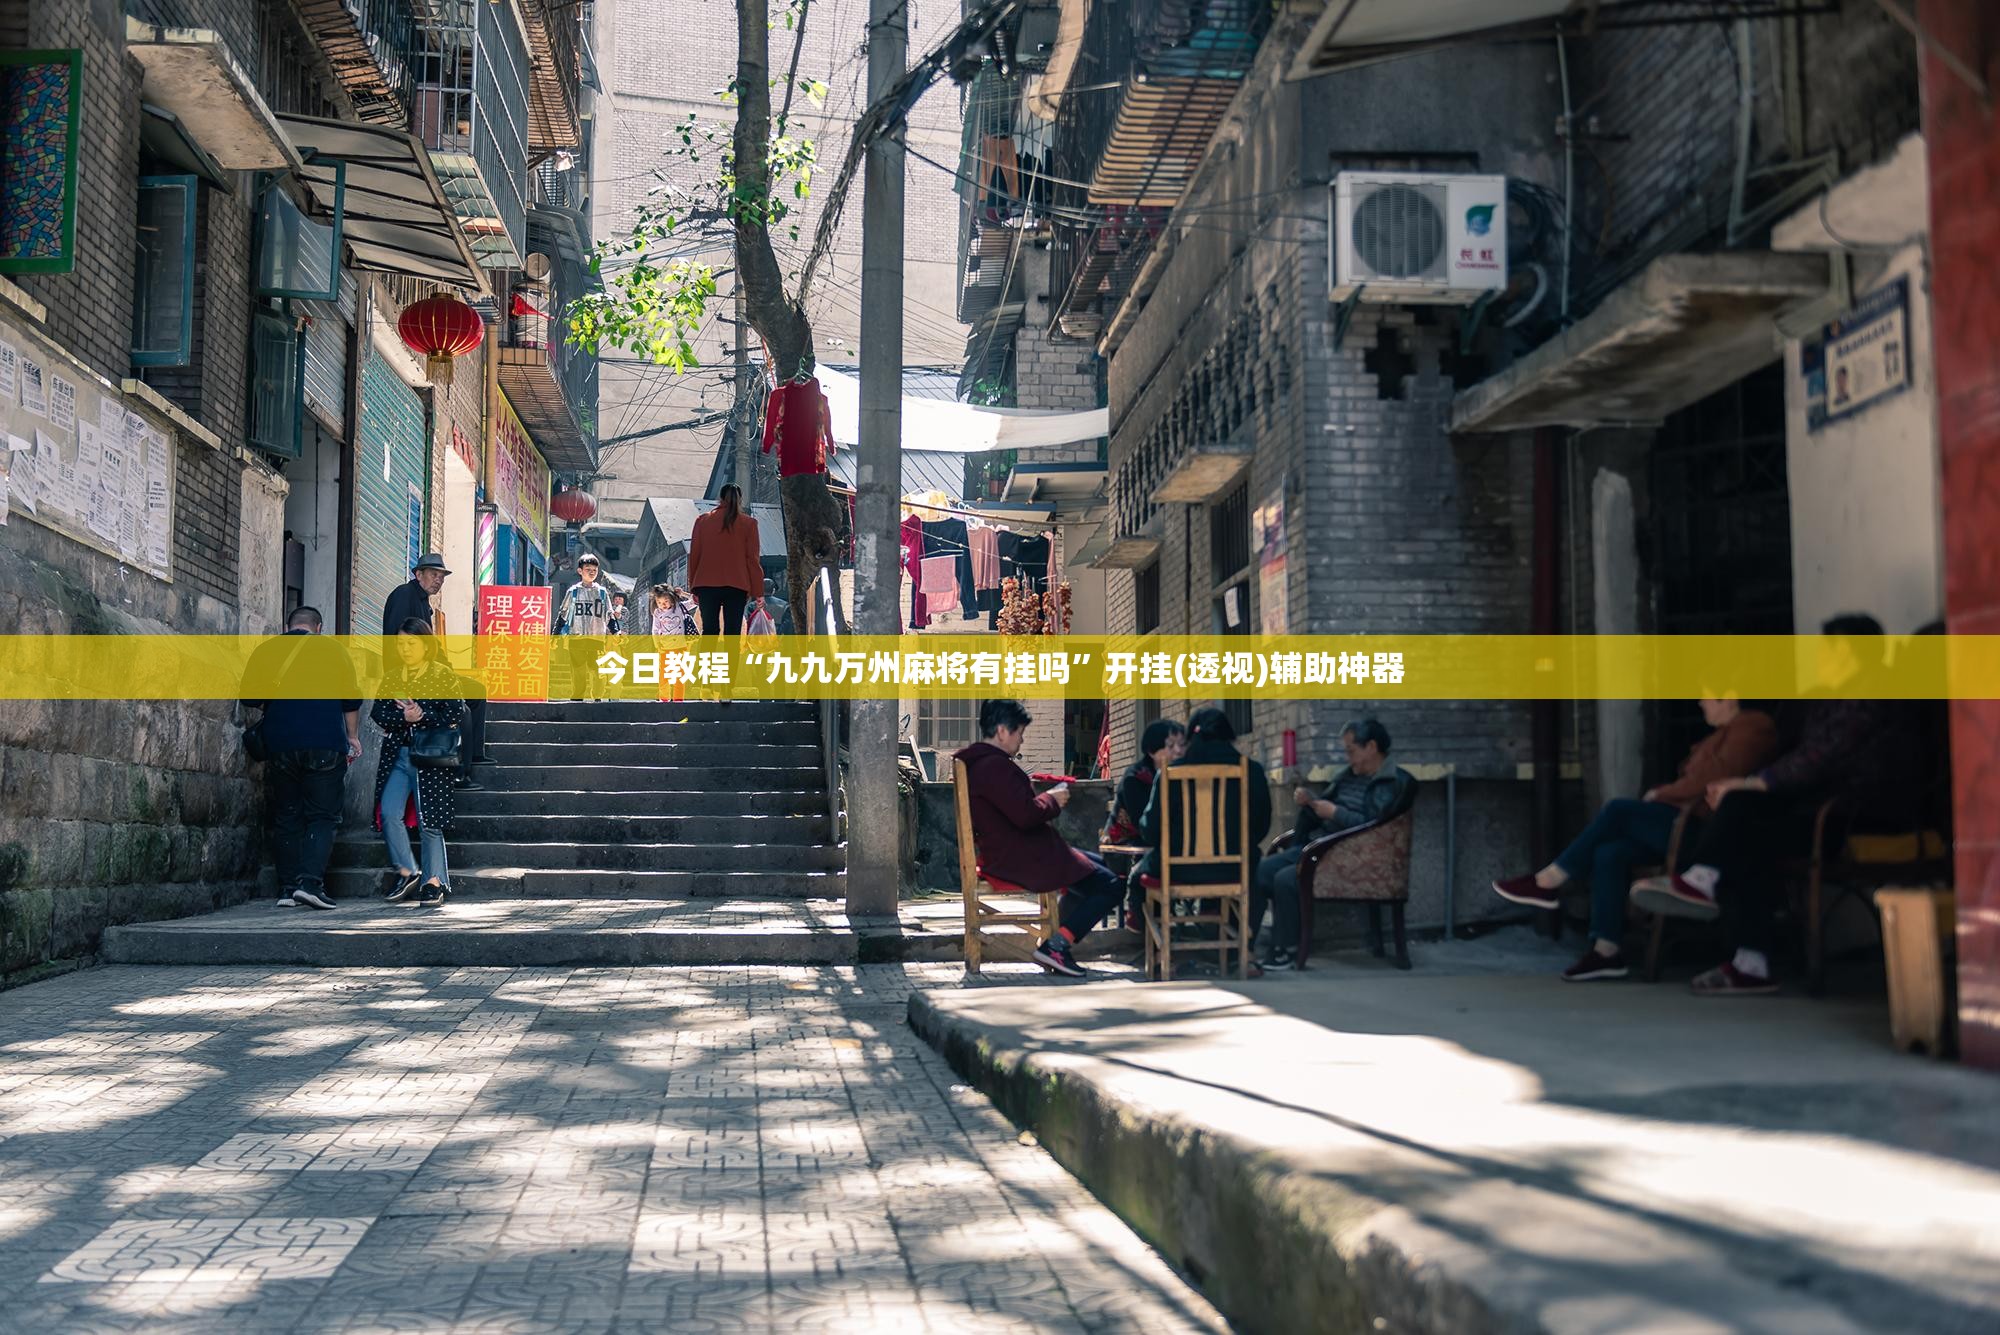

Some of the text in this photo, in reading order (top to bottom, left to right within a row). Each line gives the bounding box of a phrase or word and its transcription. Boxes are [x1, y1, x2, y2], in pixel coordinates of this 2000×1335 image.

[486, 595, 546, 620] 理发
[485, 619, 547, 645] 保健
[485, 645, 544, 671] 盘发
[486, 672, 544, 697] 洗面
